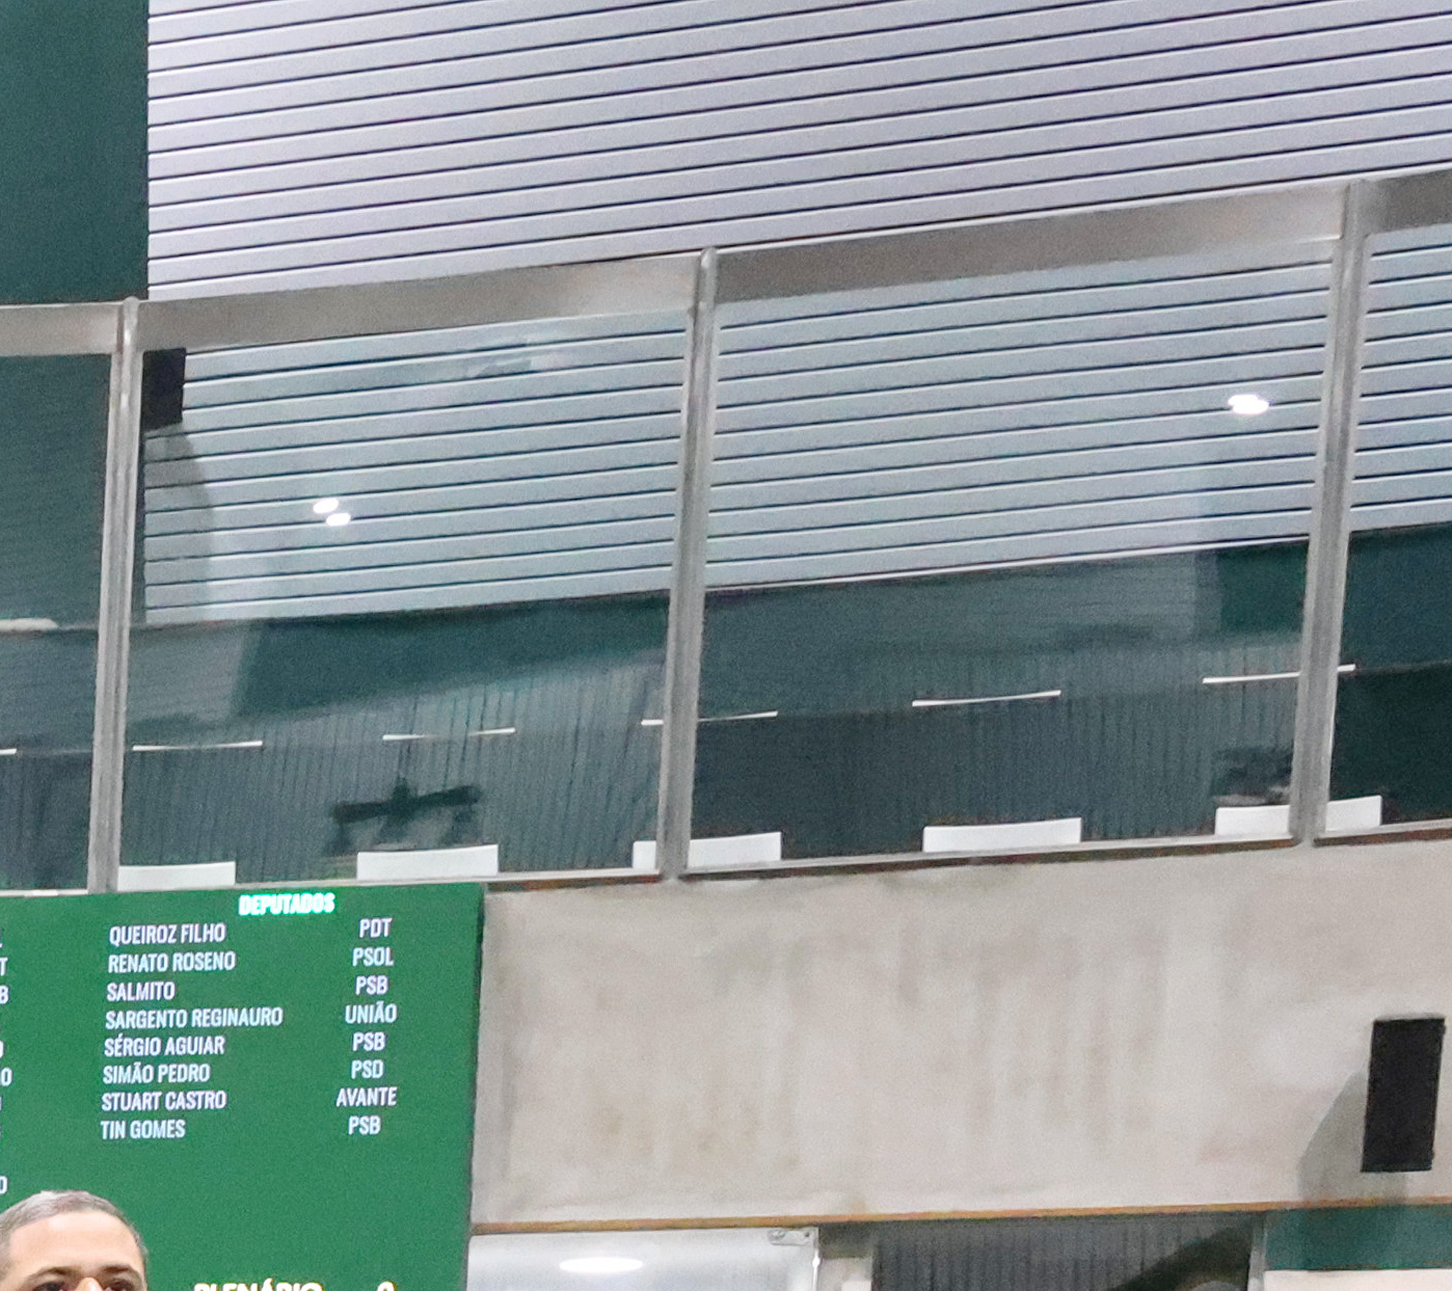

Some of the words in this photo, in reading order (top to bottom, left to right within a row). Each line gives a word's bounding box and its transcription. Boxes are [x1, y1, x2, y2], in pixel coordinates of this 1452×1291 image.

[239, 893, 335, 915] DEPUTADOS
[110, 925, 177, 946] QUEIROZ
[181, 923, 226, 943] FILHO
[360, 918, 392, 937] PDT
[109, 953, 169, 973] RENATO
[173, 951, 235, 971] ROSENO
[353, 947, 394, 966] PSOL
[107, 981, 175, 1001] SALMITO
[356, 975, 388, 995] PSB
[106, 1009, 187, 1029] SARGENTO
[192, 1007, 283, 1027] REGINAURO
[346, 1001, 397, 1023] UNIÃO
[105, 1033, 161, 1056] SÉRGIO
[164, 1036, 225, 1055] AGUIAR
[353, 1032, 385, 1051] PSB
[103, 1062, 154, 1084] SIMÃO
[158, 1064, 210, 1083] PEDRO
[352, 1060, 383, 1079] PSD
[102, 1091, 162, 1111] STUART
[165, 1090, 227, 1110] CASTRO
[336, 1087, 397, 1106] AVANTE
[101, 1121, 125, 1139] TIN
[130, 1119, 185, 1138] GOMES
[349, 1116, 381, 1134] PSB
